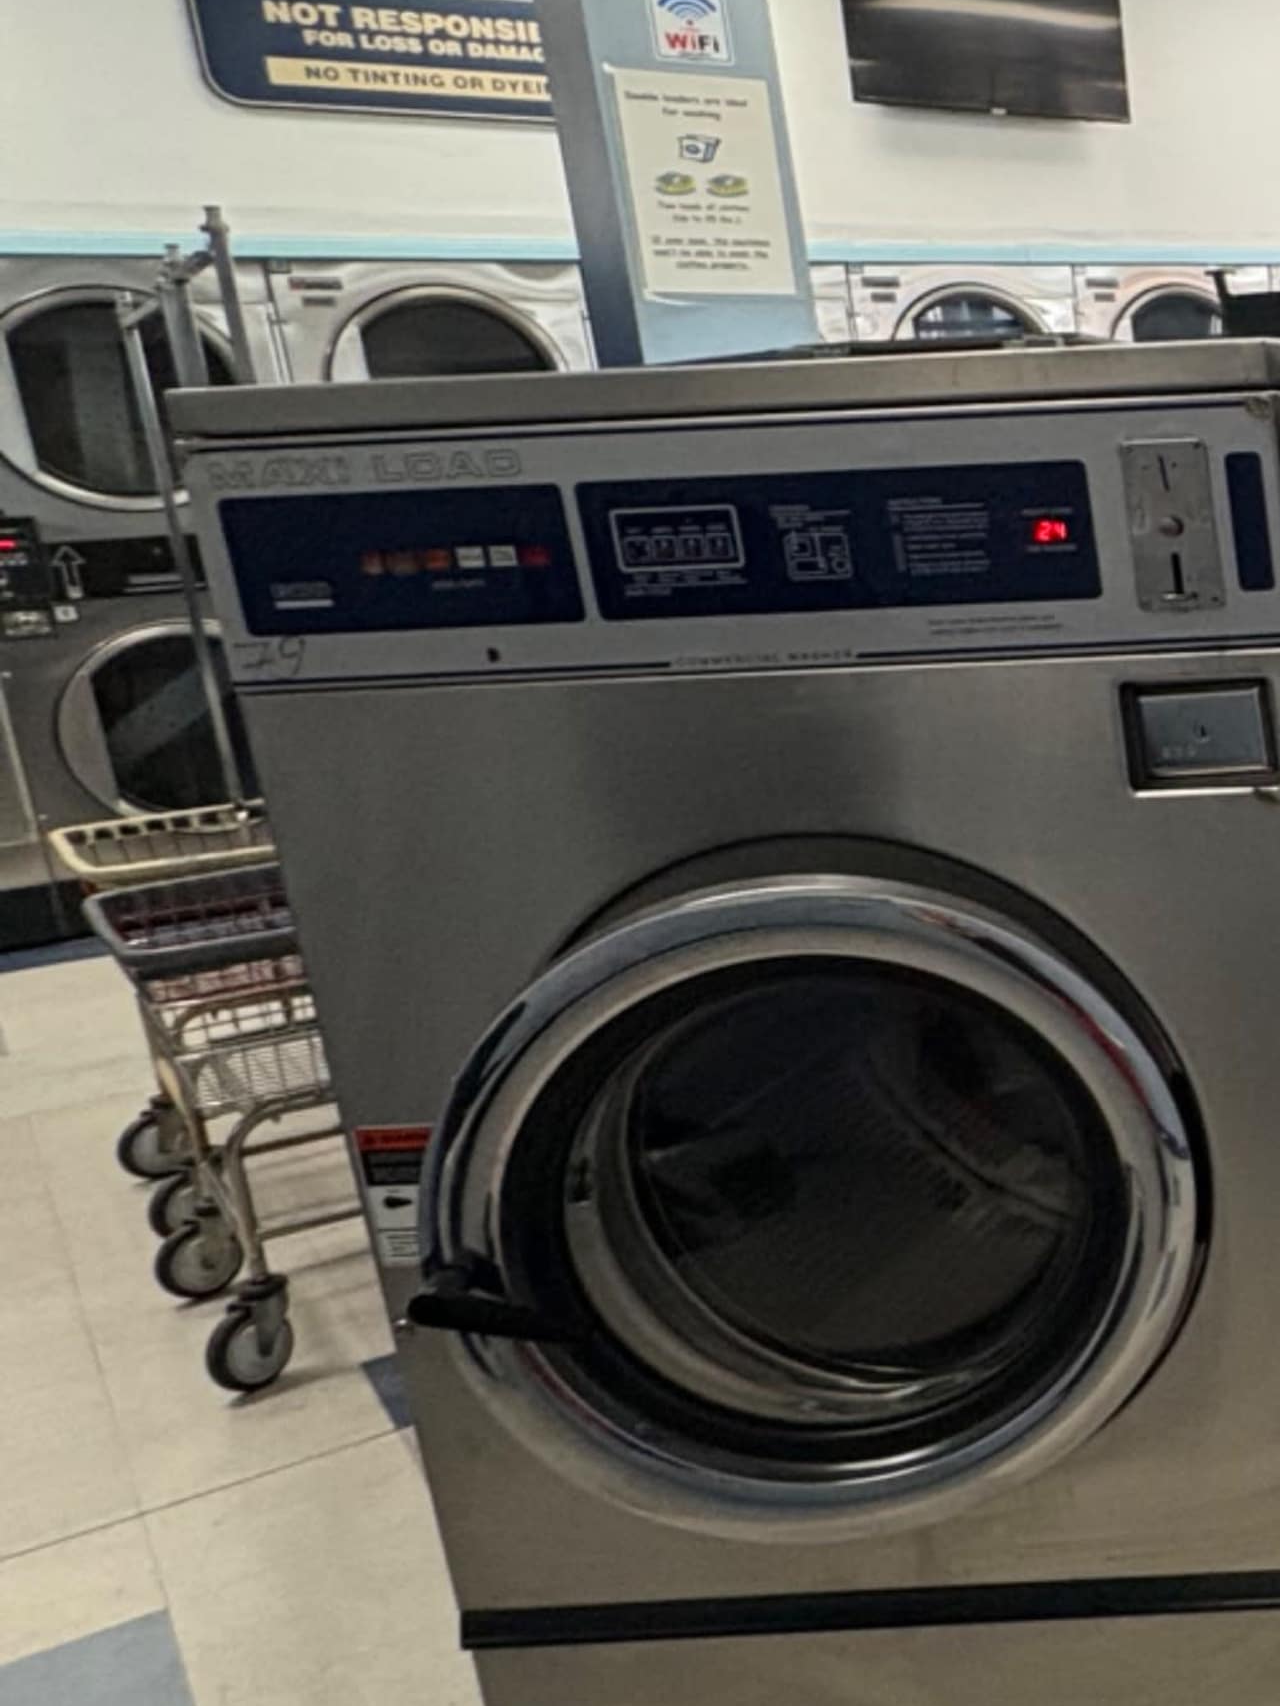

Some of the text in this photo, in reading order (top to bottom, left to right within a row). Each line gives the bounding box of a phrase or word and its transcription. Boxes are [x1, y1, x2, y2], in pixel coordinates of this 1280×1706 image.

[302, 29, 355, 48] FOR
[359, 33, 423, 53] LOSS
[428, 37, 462, 56] OR
[304, 66, 551, 94] NO TINTING OR DYEI
[369, 448, 521, 482] LOAD
